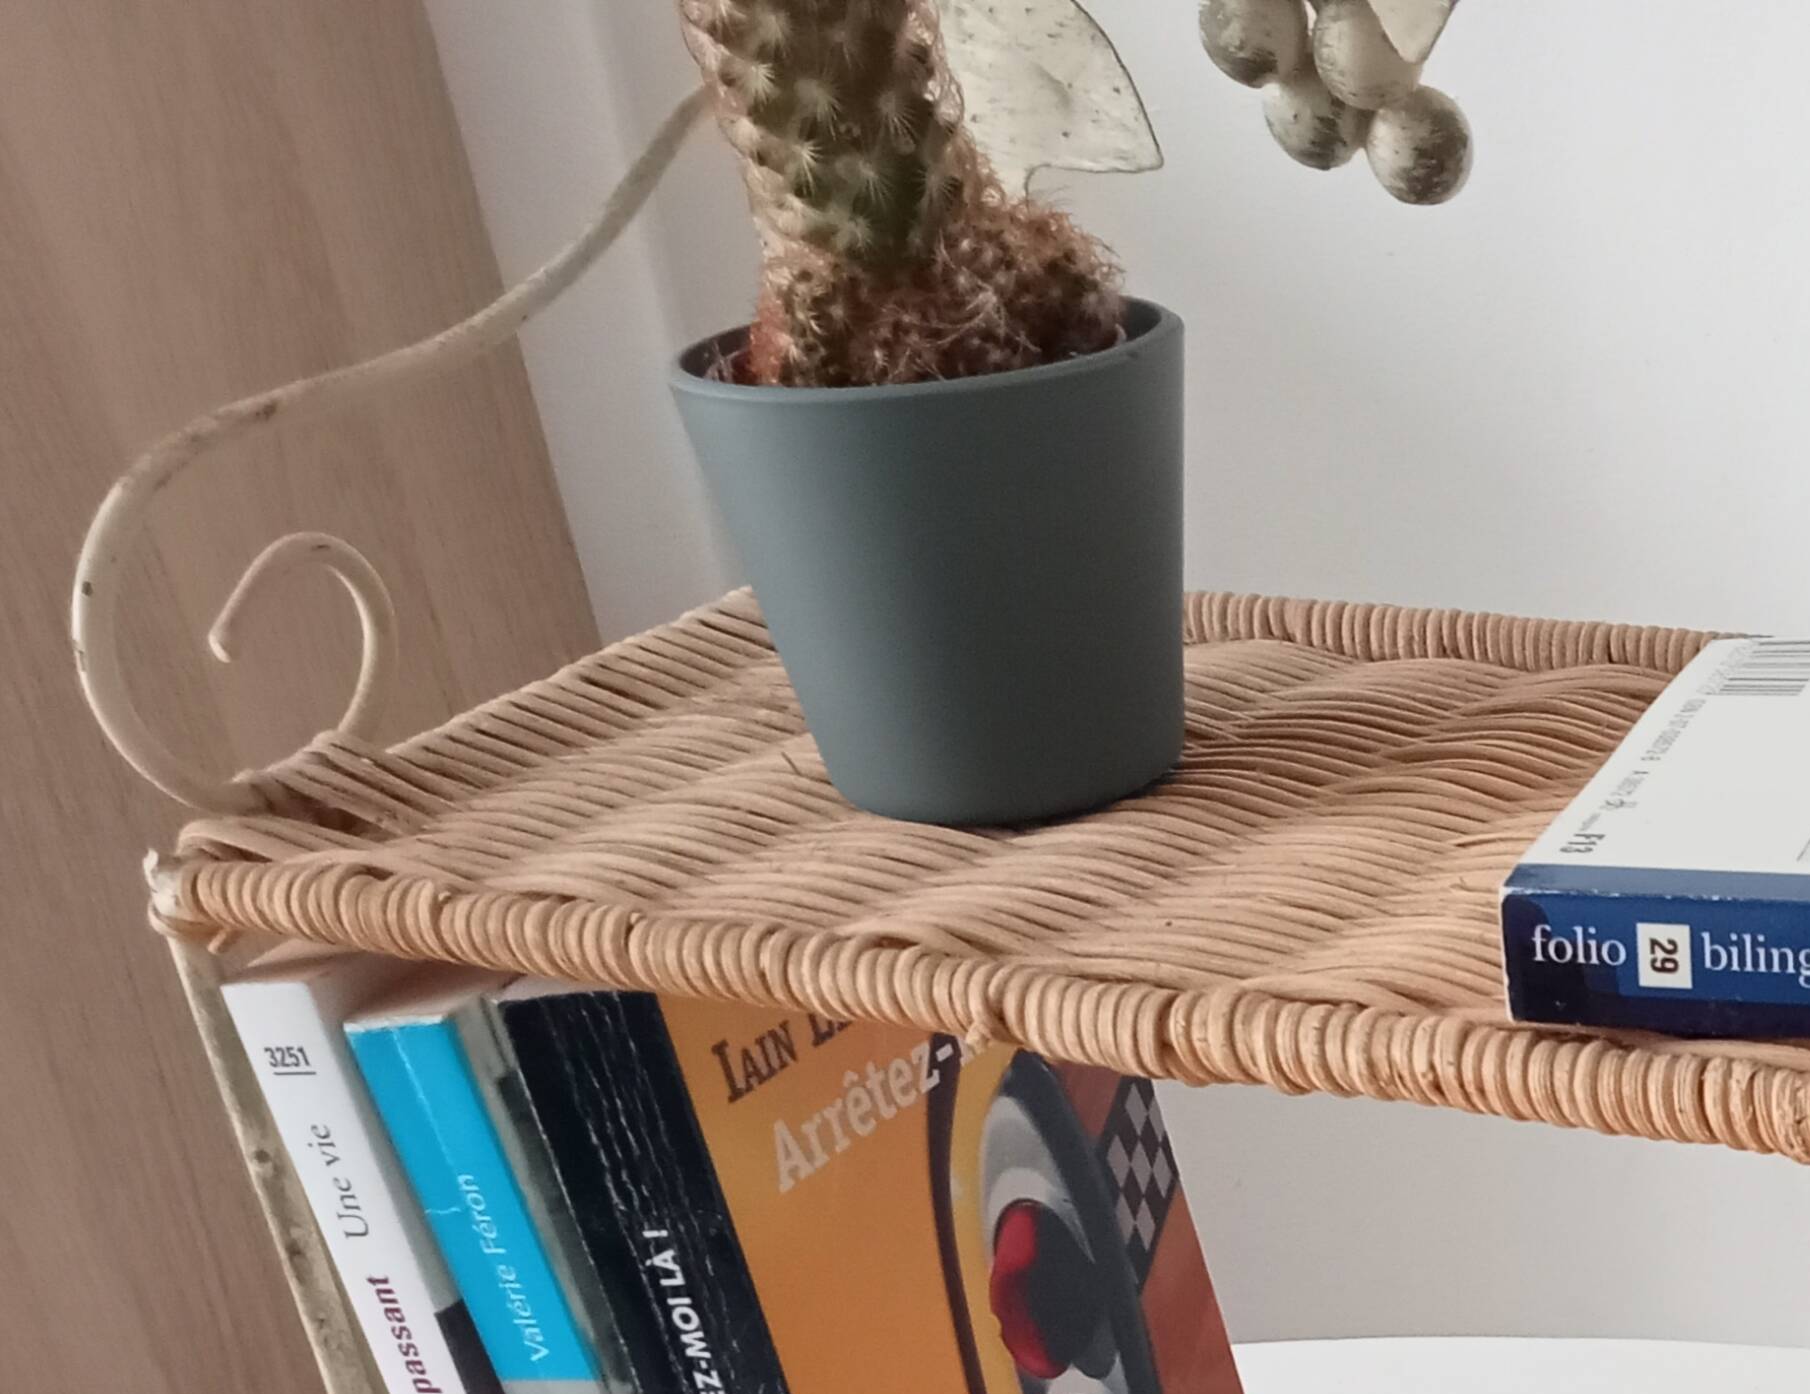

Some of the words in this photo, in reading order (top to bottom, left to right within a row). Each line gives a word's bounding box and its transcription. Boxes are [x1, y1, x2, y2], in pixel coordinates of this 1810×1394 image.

[1531, 924, 1627, 966] folio
[1649, 937, 1679, 975] 29
[264, 1046, 312, 1068] 3251
[306, 1124, 343, 1170] vie
[331, 1175, 370, 1240] Une
[457, 1173, 508, 1256] Féron
[644, 1248, 687, 1288] LÀ
[498, 1263, 550, 1363] Valérie
